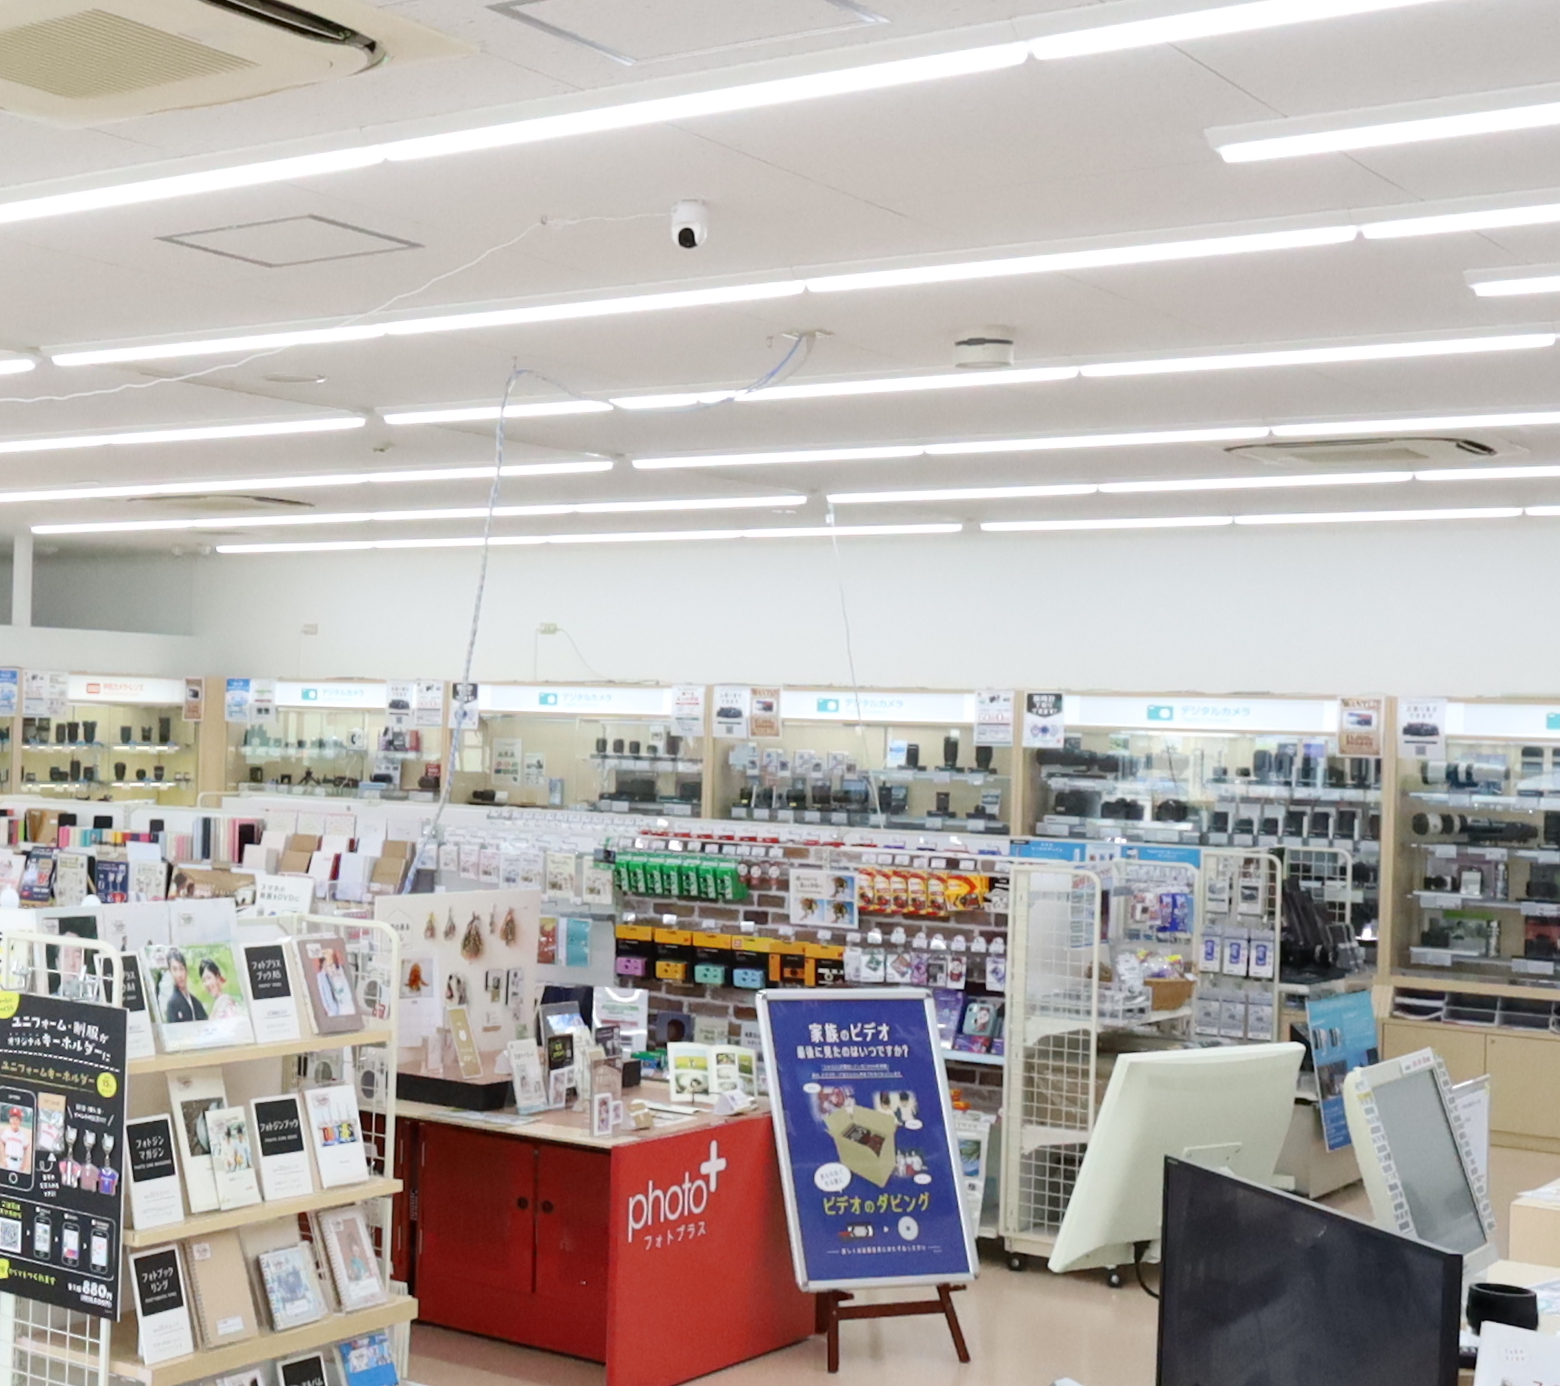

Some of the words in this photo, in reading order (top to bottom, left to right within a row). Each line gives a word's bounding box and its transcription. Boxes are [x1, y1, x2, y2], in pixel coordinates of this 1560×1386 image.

[1181, 705, 1251, 718] デジタルカメラ
[251, 958, 281, 970] フォトプラス
[11, 1015, 110, 1045] ユニフォーム・制服が
[808, 1022, 890, 1044] 家族のビデオ
[796, 1044, 910, 1060] 最後に見たのはいつですか?
[0, 1059, 96, 1086] ユニフォームキーホルダー
[259, 1117, 299, 1133] フォトジンブック
[135, 1135, 164, 1150] フォトジン
[138, 1147, 165, 1161] マガジン
[823, 1192, 931, 1216] ビデオのダビング
[644, 1220, 706, 1251] フォトプラス
[142, 1266, 174, 1283] フォトブック
[151, 1278, 169, 1292] リング
